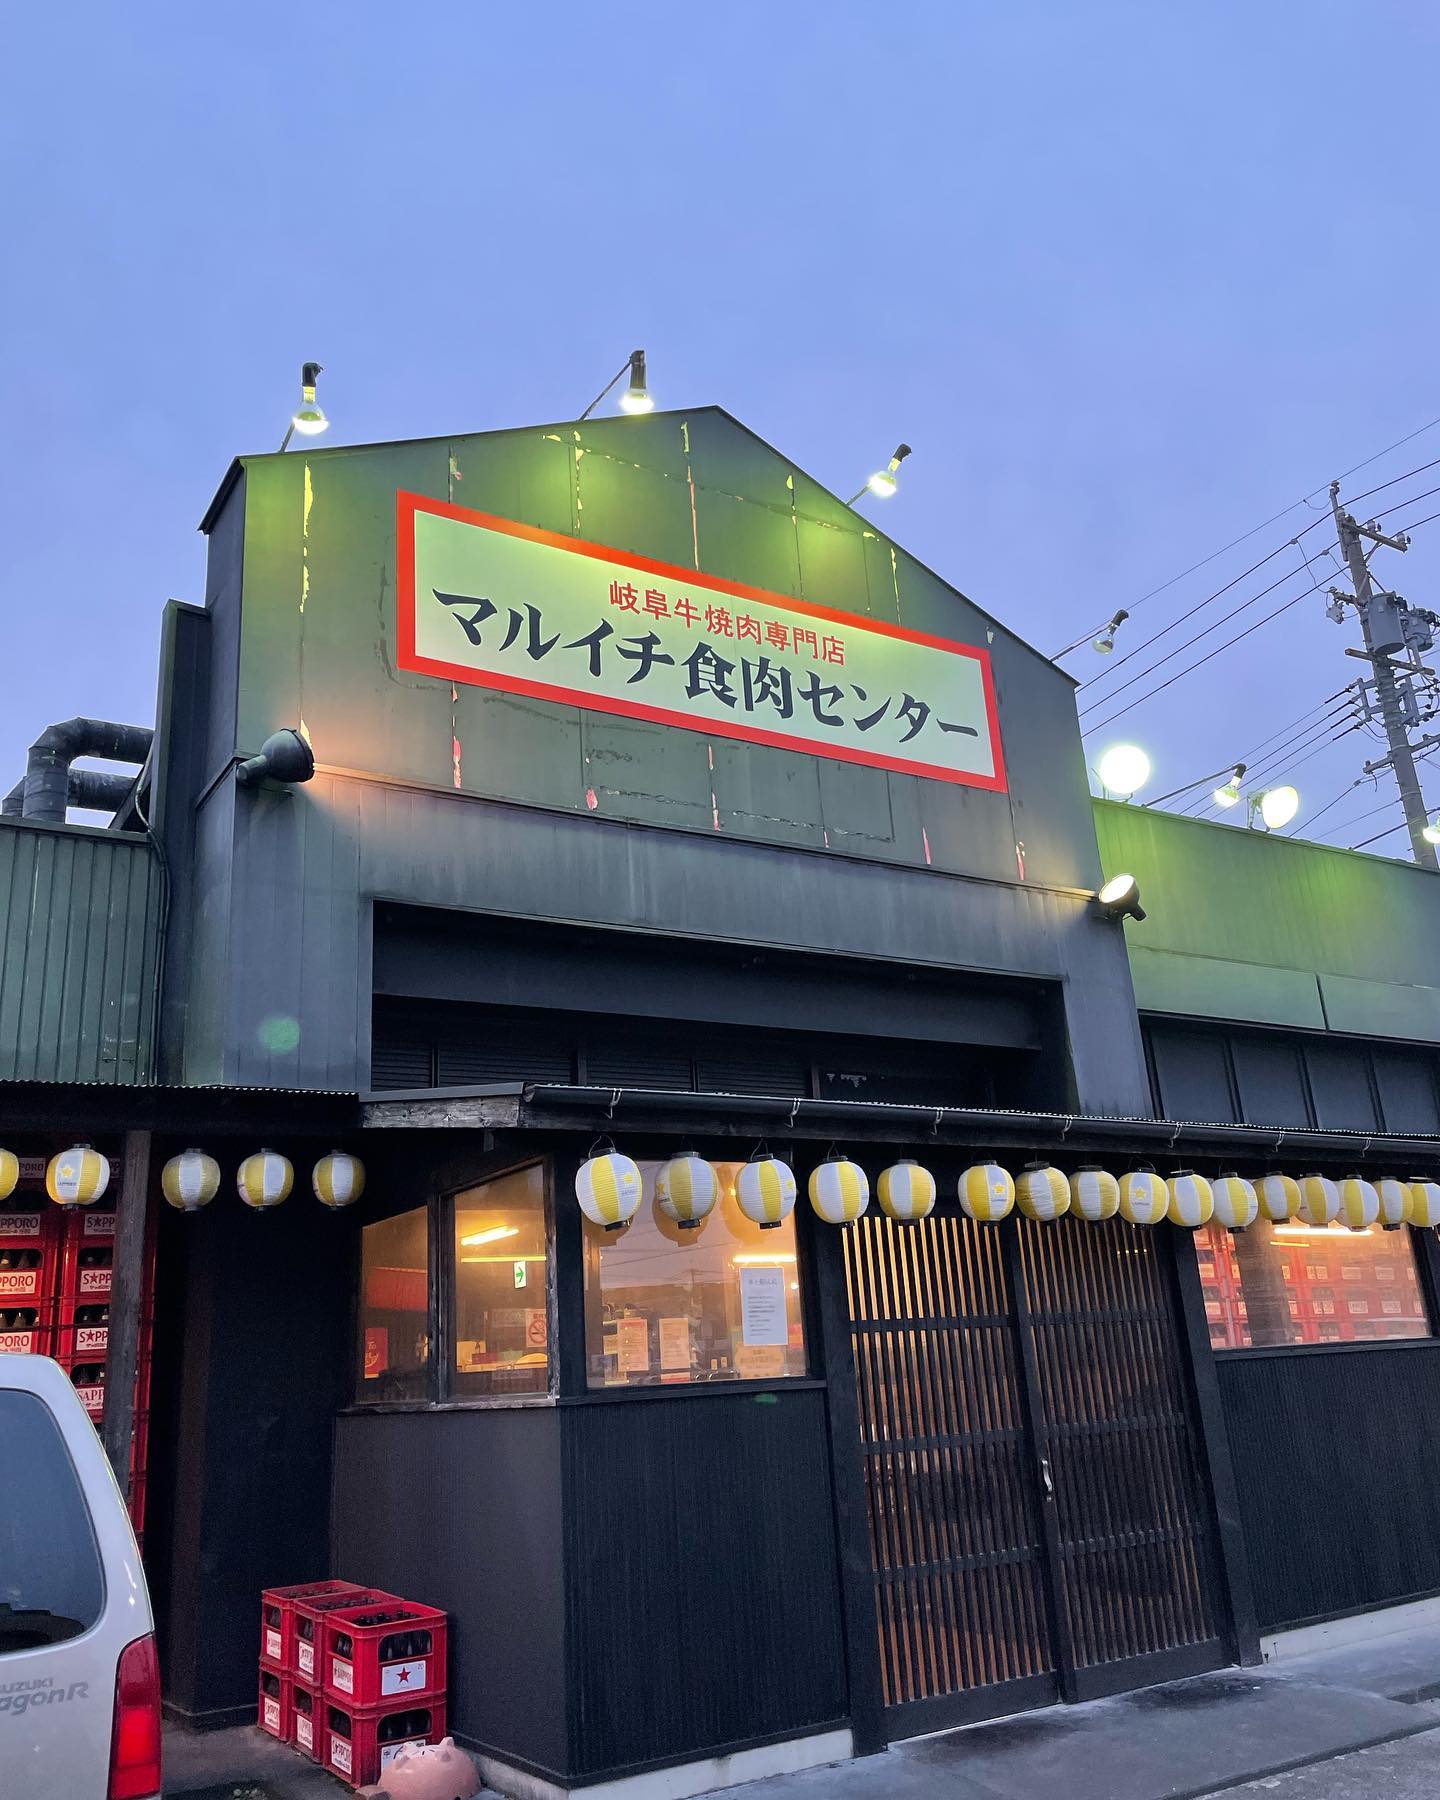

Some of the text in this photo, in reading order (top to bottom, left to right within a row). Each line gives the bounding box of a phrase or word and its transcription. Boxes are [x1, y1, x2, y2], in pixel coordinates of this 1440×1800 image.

[432, 588, 978, 743] マルイチ食肉センター
[609, 580, 844, 666] 岐阜牛焼肉専門店
[0, 1678, 53, 1694] UZUKI
